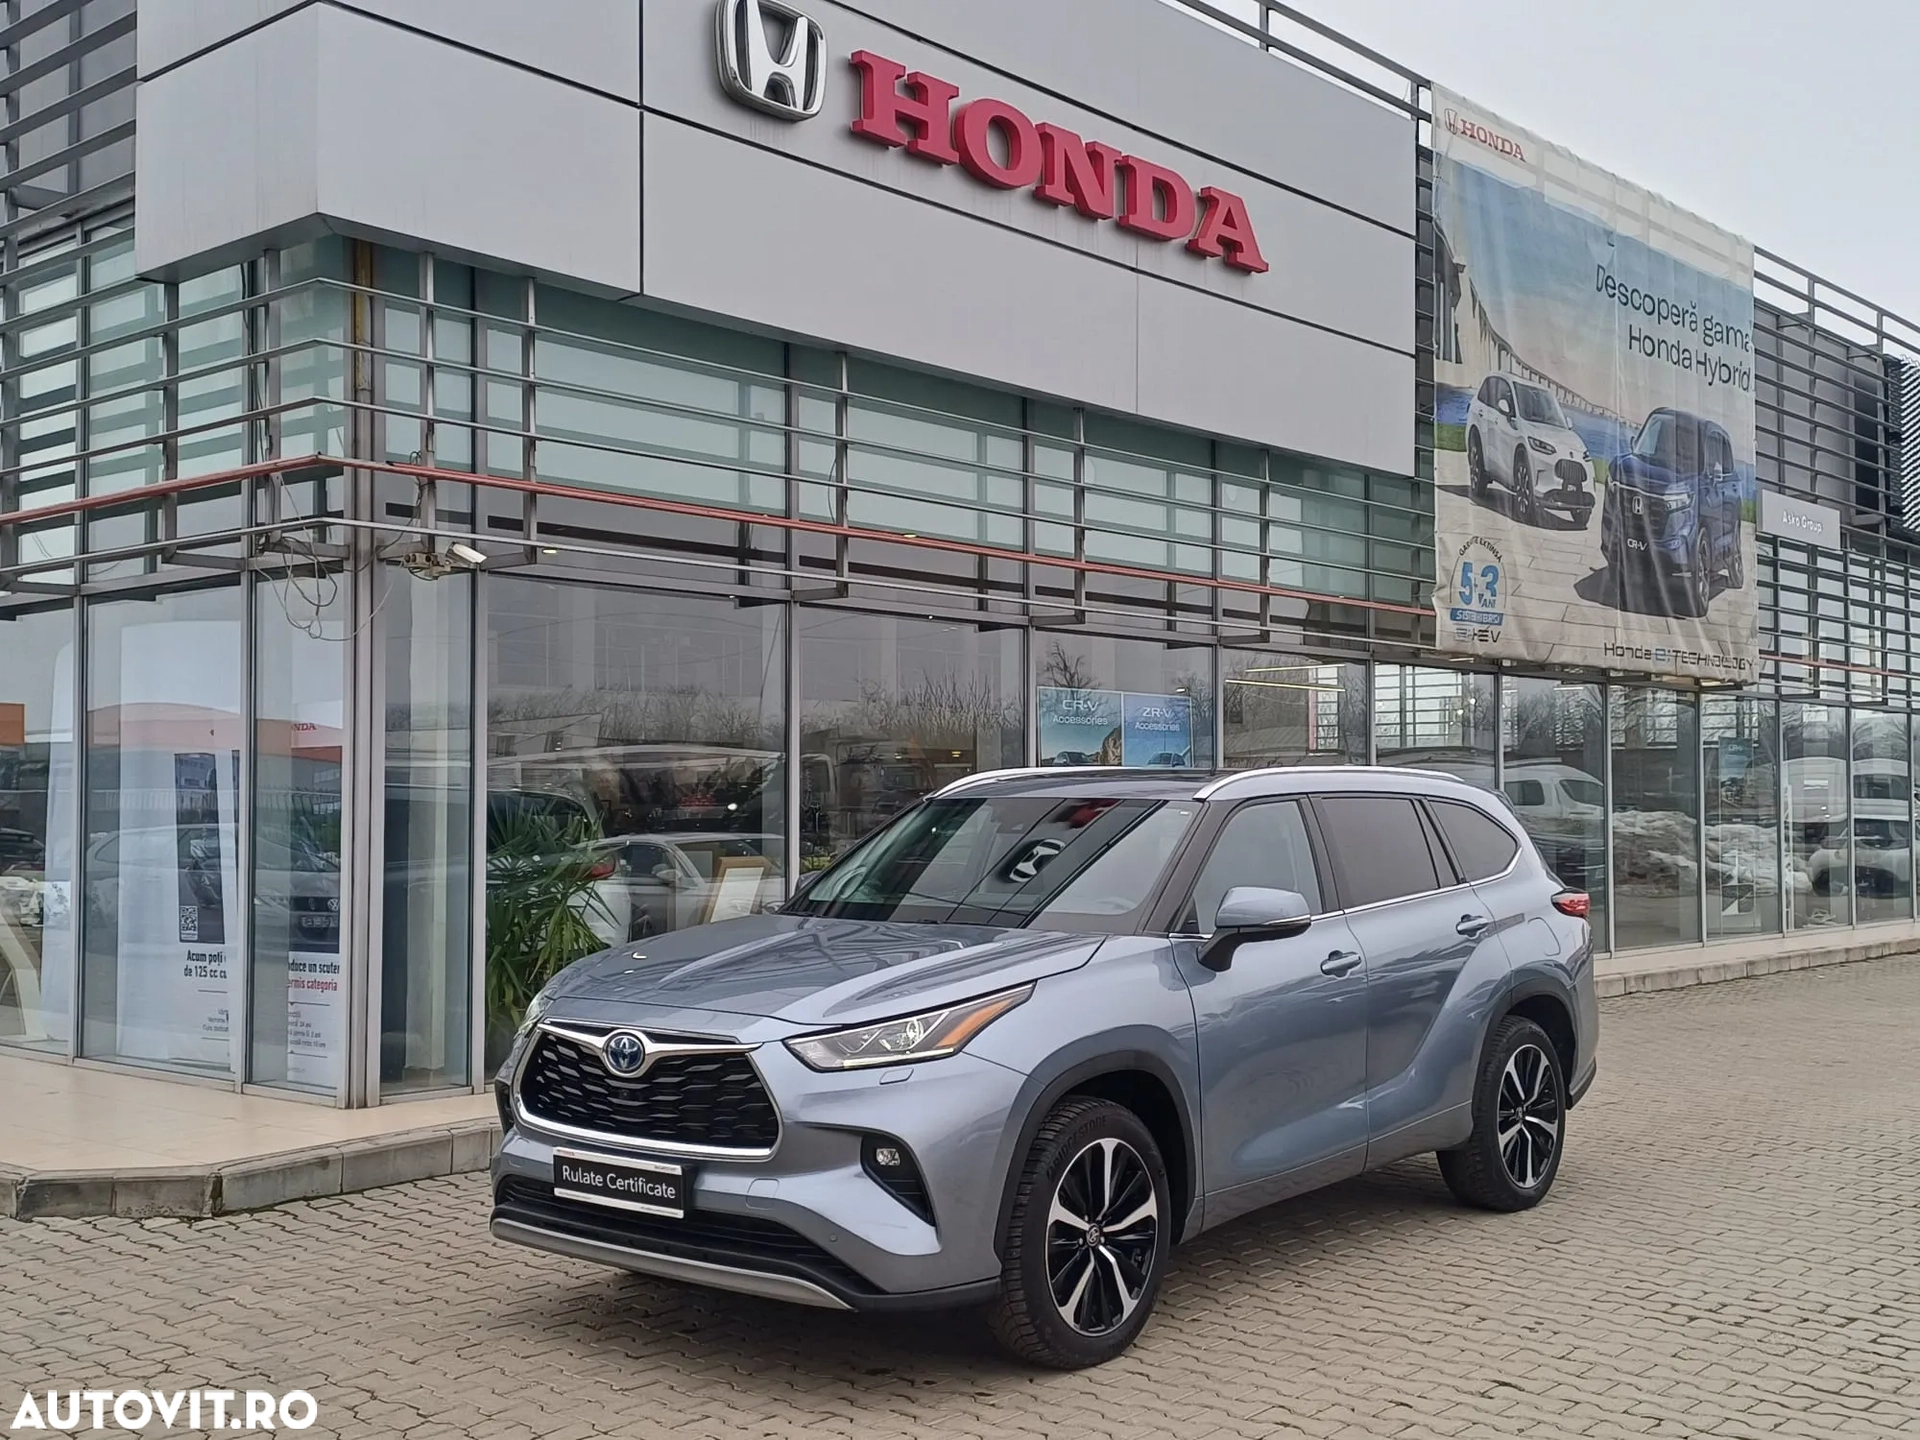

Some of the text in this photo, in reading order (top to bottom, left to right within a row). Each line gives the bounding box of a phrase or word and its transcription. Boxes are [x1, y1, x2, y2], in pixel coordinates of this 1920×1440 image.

[1460, 118, 1527, 163] HONDA
[849, 49, 1269, 274] HONDA
[1596, 263, 1751, 353] Descoperă gama
[1628, 324, 1751, 392] Honda Hybrid
[1782, 510, 1823, 534] Asko Group
[1603, 642, 1651, 660] Honda
[1062, 699, 1099, 713] CR-V
[1142, 706, 1175, 719] ZR-V
[1052, 714, 1108, 726] Accessories
[1134, 721, 1181, 733] Accessories
[186, 949, 207, 963] Acum
[183, 965, 193, 977] de
[194, 965, 208, 978] 125
[209, 968, 219, 979] cc
[306, 979, 338, 993] categoria
[562, 1165, 676, 1199] Rulate Certificate
